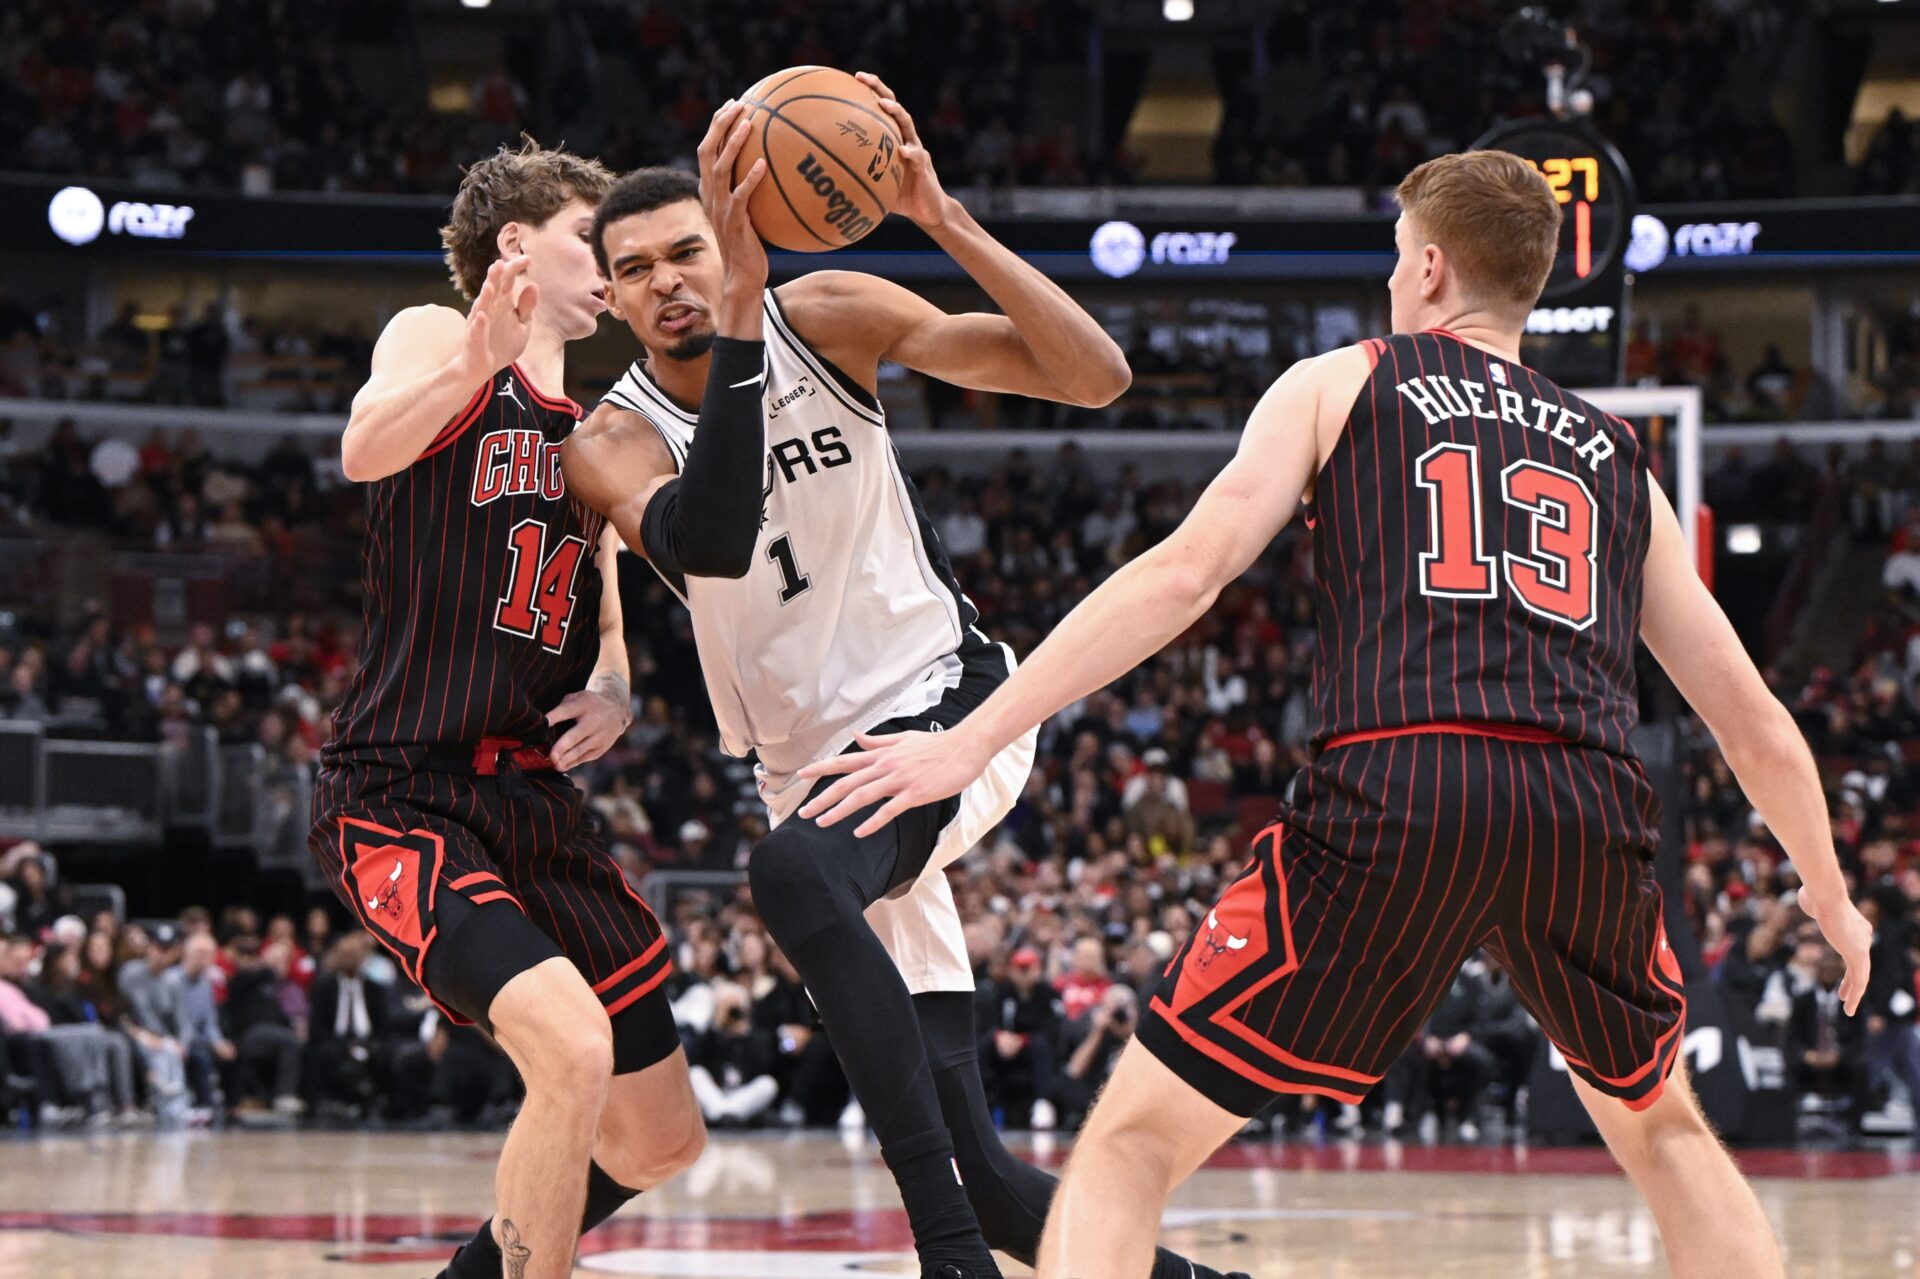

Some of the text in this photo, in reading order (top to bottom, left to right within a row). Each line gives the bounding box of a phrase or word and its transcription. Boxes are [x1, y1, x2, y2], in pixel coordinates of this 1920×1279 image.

[797, 151, 875, 242] Wilson
[1526, 157, 1599, 204] 27
[1575, 200, 1592, 279] 1
[1525, 306, 1615, 334] ISSOT
[771, 385, 807, 411] LEDGER
[1395, 375, 1615, 472] HUERTER
[764, 530, 814, 607] 1
[1415, 441, 1599, 632] 13
[493, 518, 588, 655] 14
